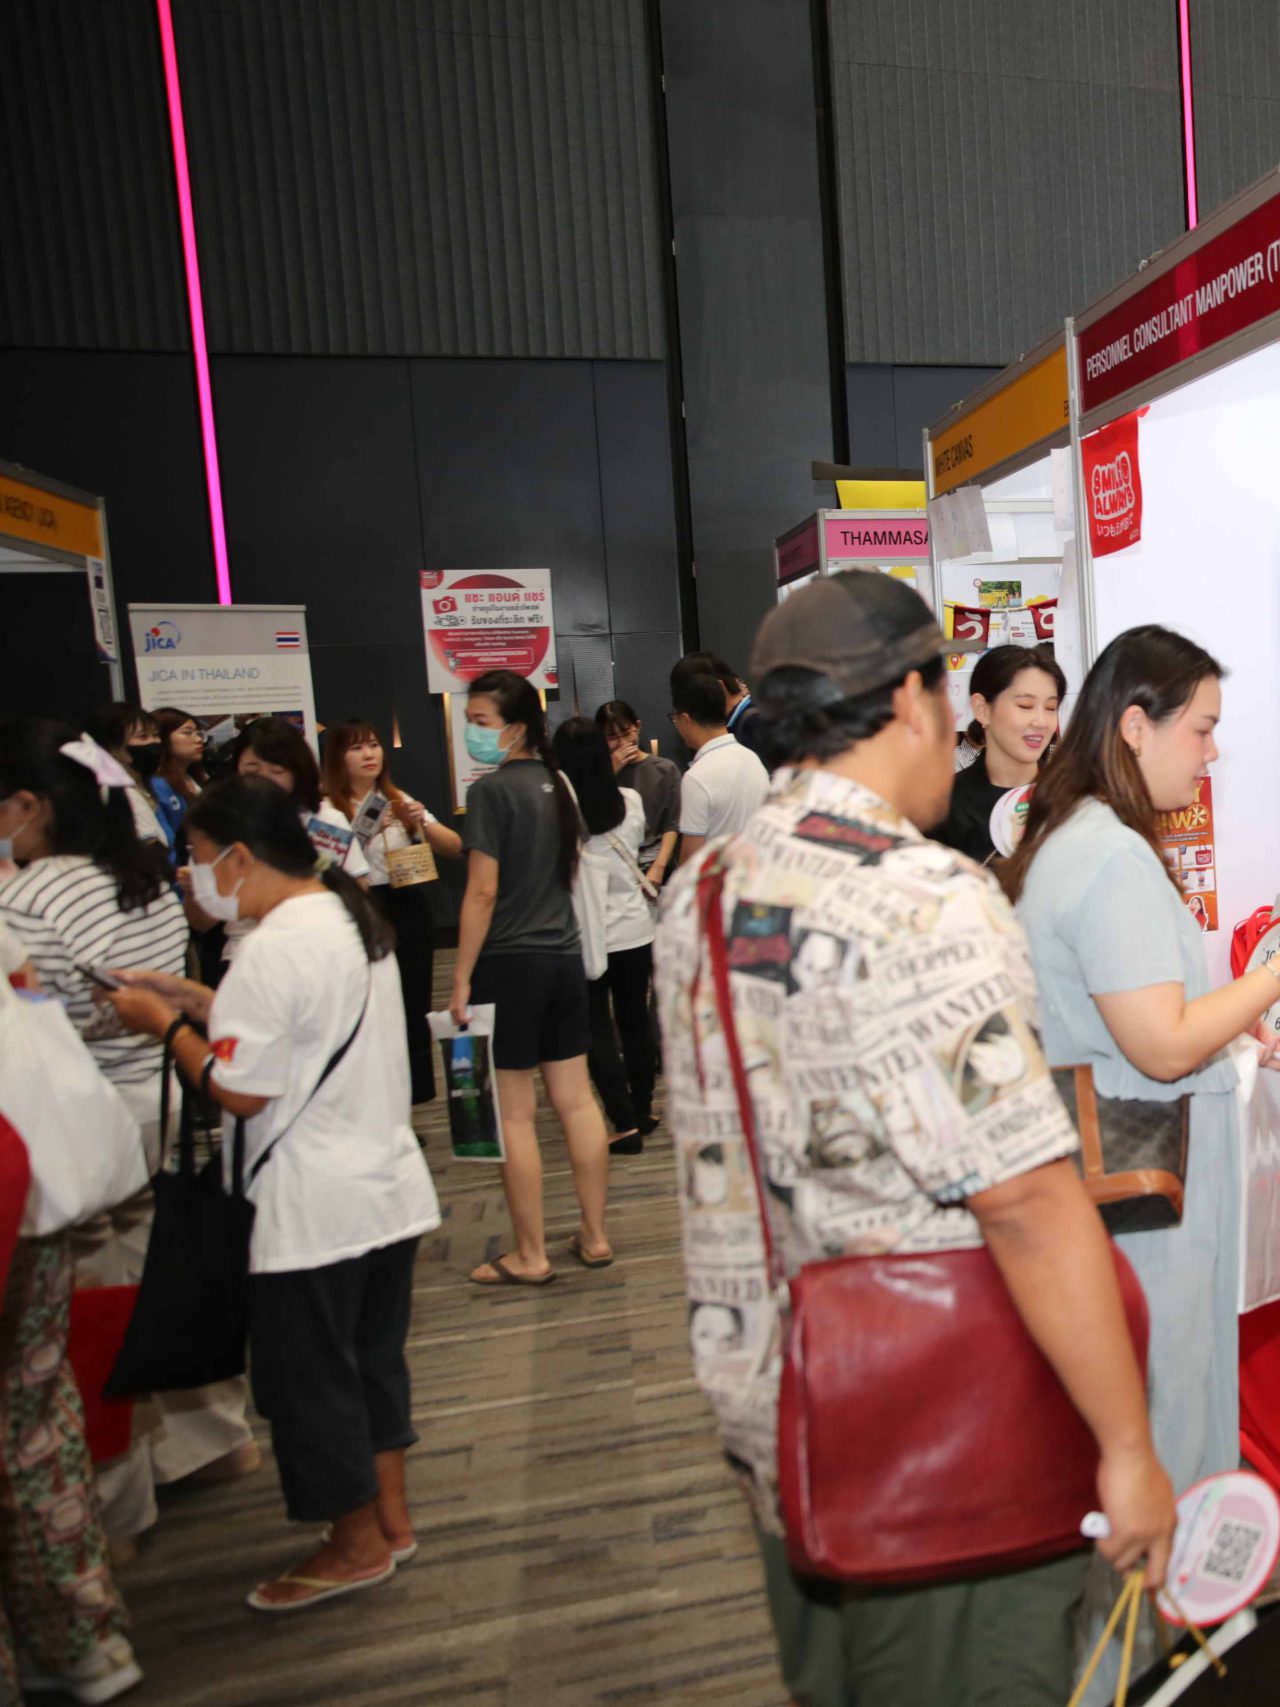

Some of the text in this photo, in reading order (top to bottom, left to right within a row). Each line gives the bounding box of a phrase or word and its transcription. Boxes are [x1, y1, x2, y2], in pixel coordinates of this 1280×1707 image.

[1086, 343, 1134, 381] PERSONNEL
[1133, 294, 1194, 351] CONSULTANT
[1195, 252, 1265, 317] MANPOWER
[149, 666, 260, 682] JICA IN THAILAND
